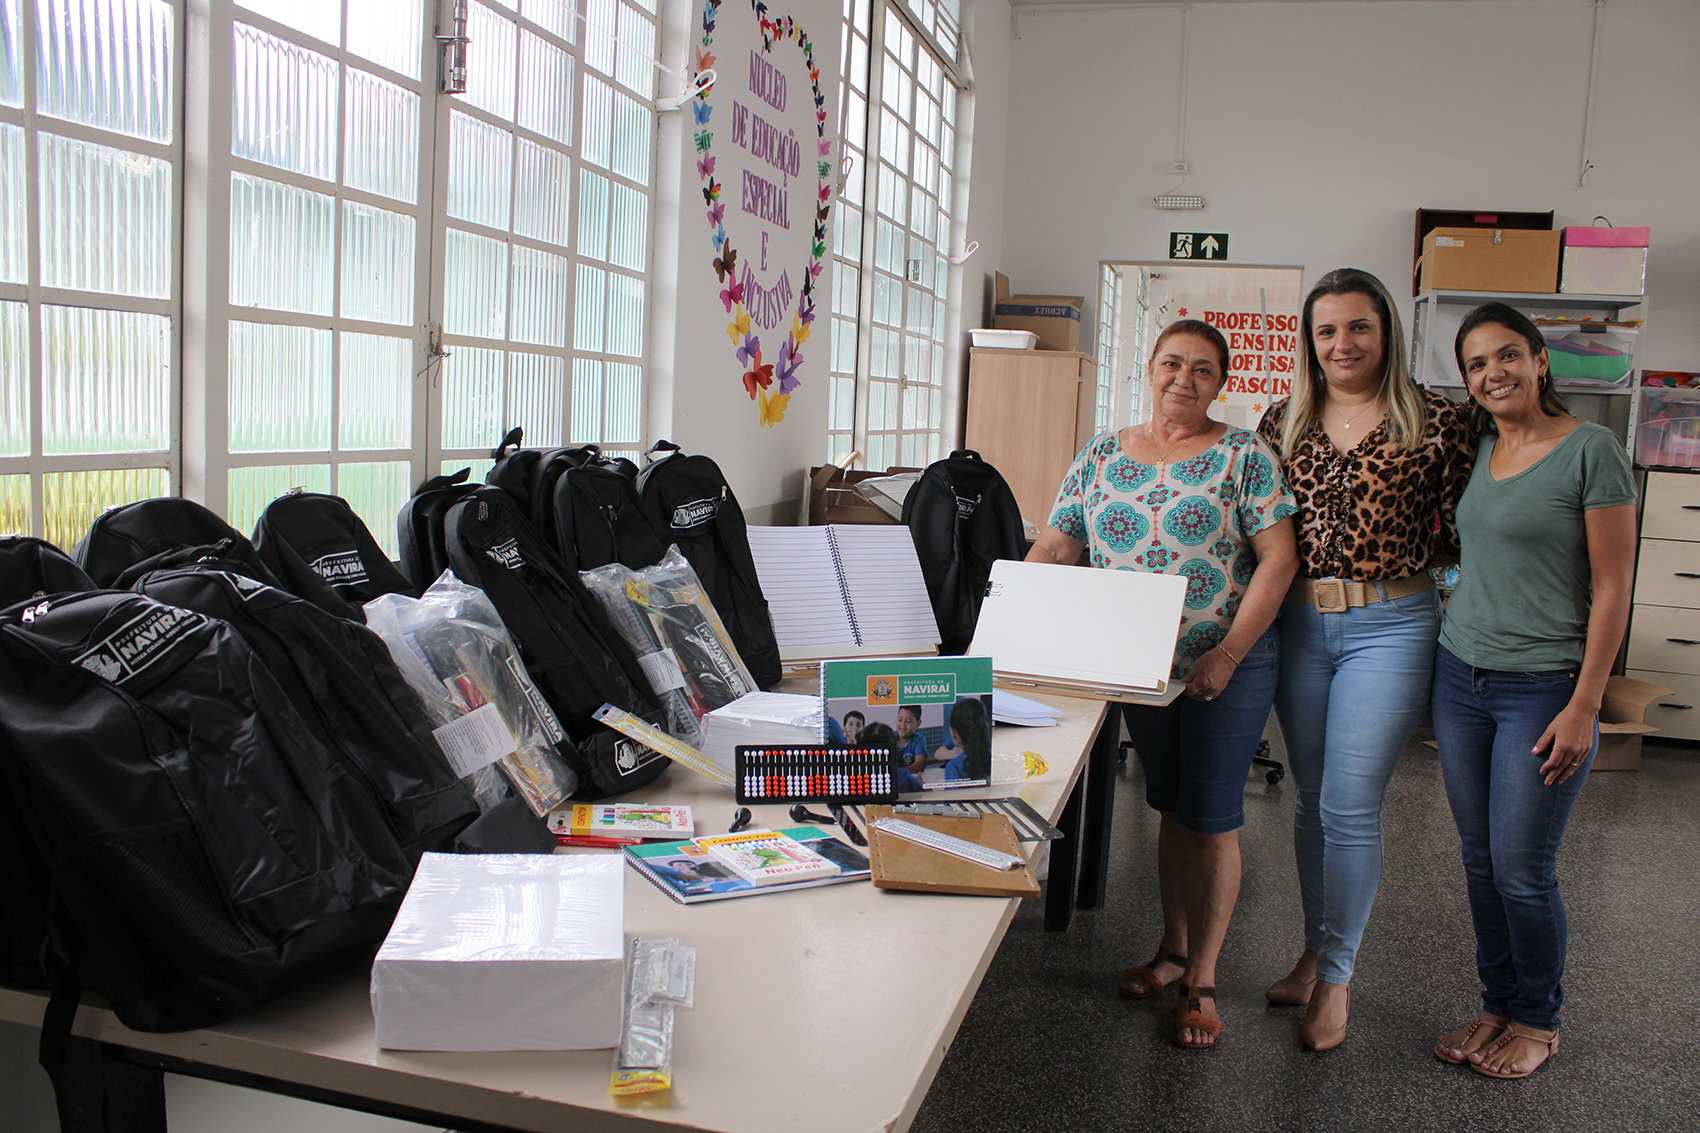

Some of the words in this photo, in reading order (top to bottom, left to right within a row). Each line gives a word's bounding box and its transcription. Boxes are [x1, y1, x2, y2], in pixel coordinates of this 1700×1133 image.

[749, 45, 787, 112] NÚCLEO
[732, 100, 749, 150] DE
[751, 113, 800, 187] EDUCAÇÃO
[741, 169, 790, 230] ESPECIAL
[760, 231, 769, 272] E
[740, 258, 793, 330] INCLUSIVA
[115, 612, 163, 648] PREFEITURA
[903, 682, 950, 695] NAVIRAÍ
